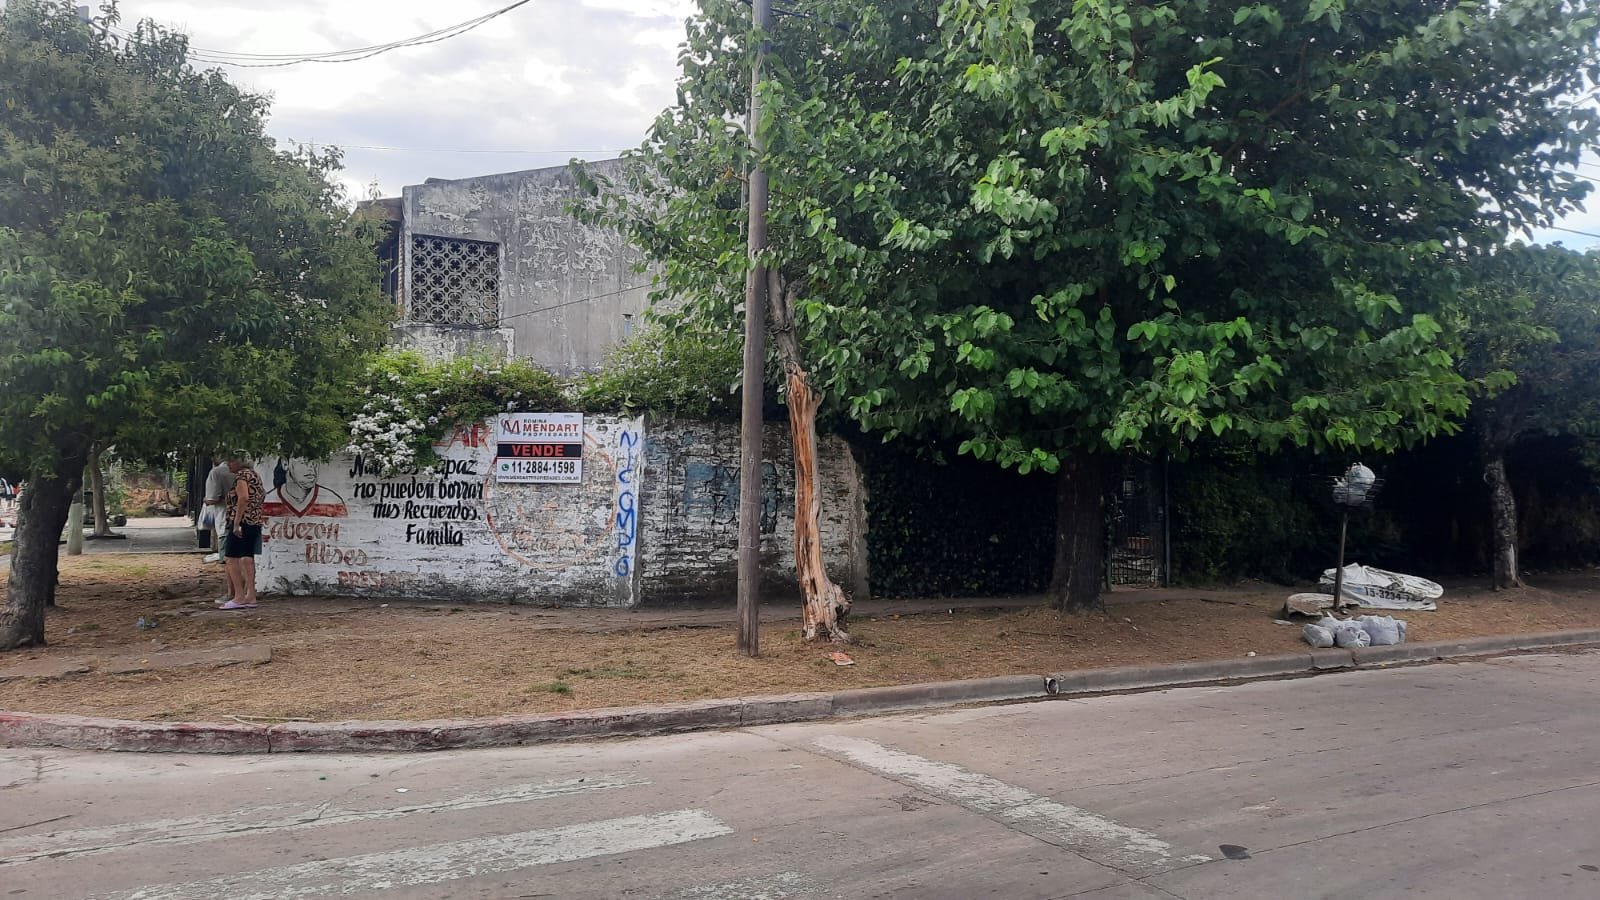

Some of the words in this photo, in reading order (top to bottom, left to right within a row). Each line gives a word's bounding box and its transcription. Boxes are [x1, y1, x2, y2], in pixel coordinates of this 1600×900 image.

[523, 424, 579, 432] MENDART
[512, 445, 564, 456] VENDE
[433, 459, 477, 480] apaz
[512, 461, 575, 474] 11-2884-1598
[353, 481, 376, 499] no
[380, 476, 435, 502] pueden
[438, 478, 484, 499] borrar
[373, 501, 400, 519] mis
[406, 521, 464, 546] Familia
[305, 541, 368, 566] Ulises
